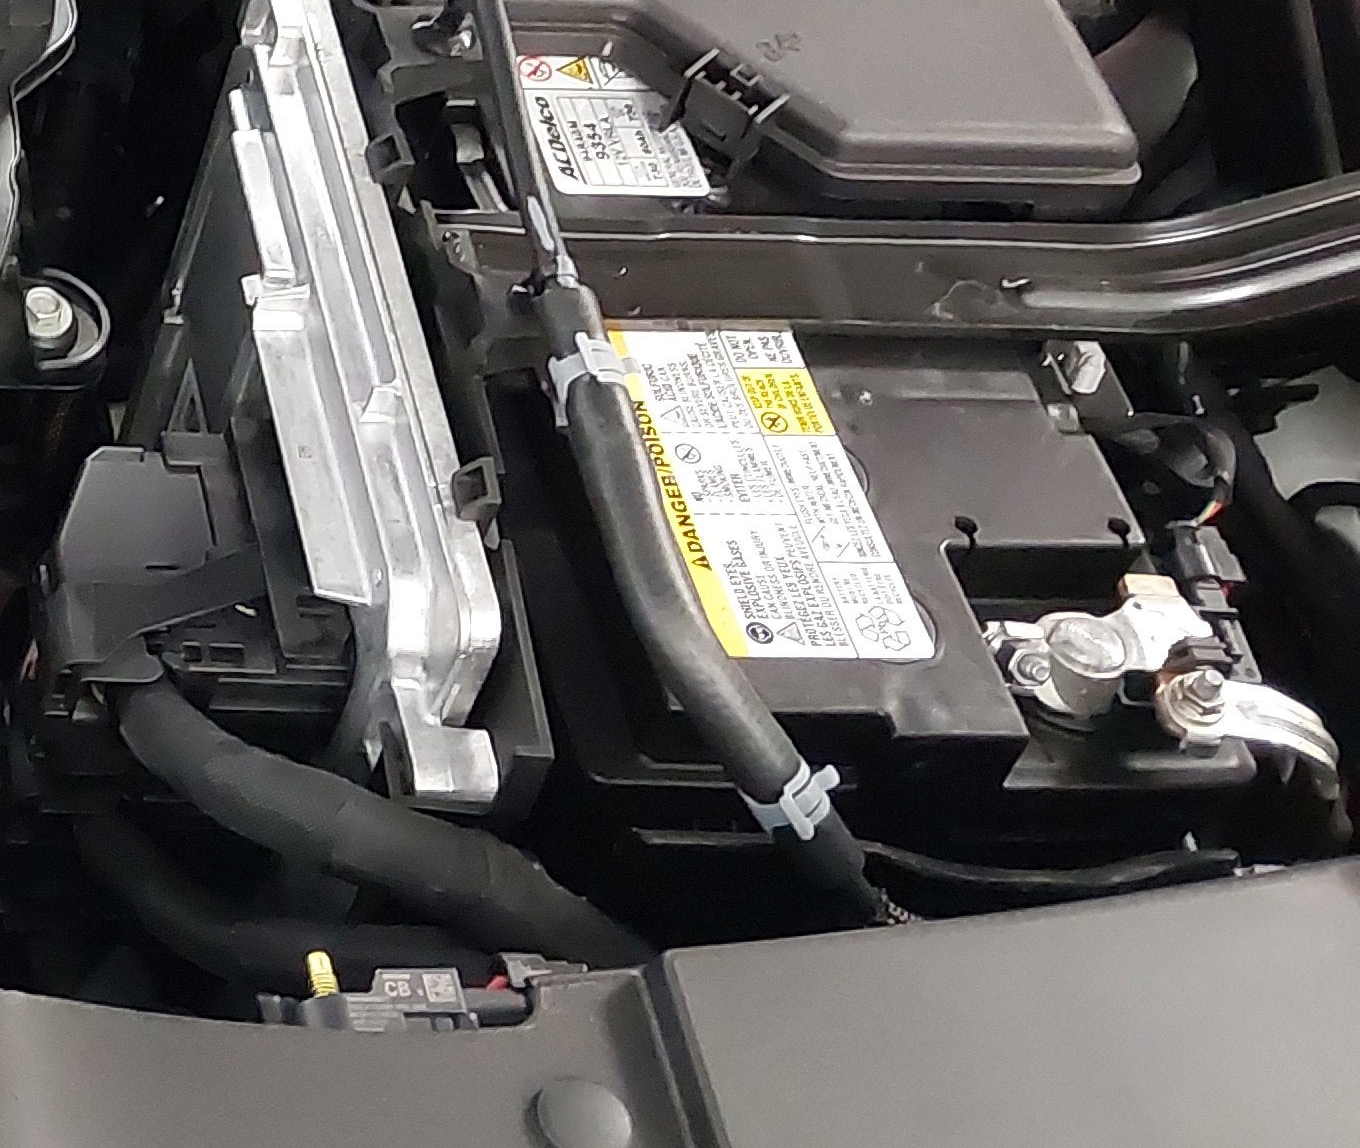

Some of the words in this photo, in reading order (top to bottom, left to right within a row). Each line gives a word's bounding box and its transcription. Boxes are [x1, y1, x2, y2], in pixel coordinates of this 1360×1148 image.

[535, 96, 577, 179] ACDelco
[631, 400, 702, 552] DANGER/POISON
[384, 981, 411, 997] CB
